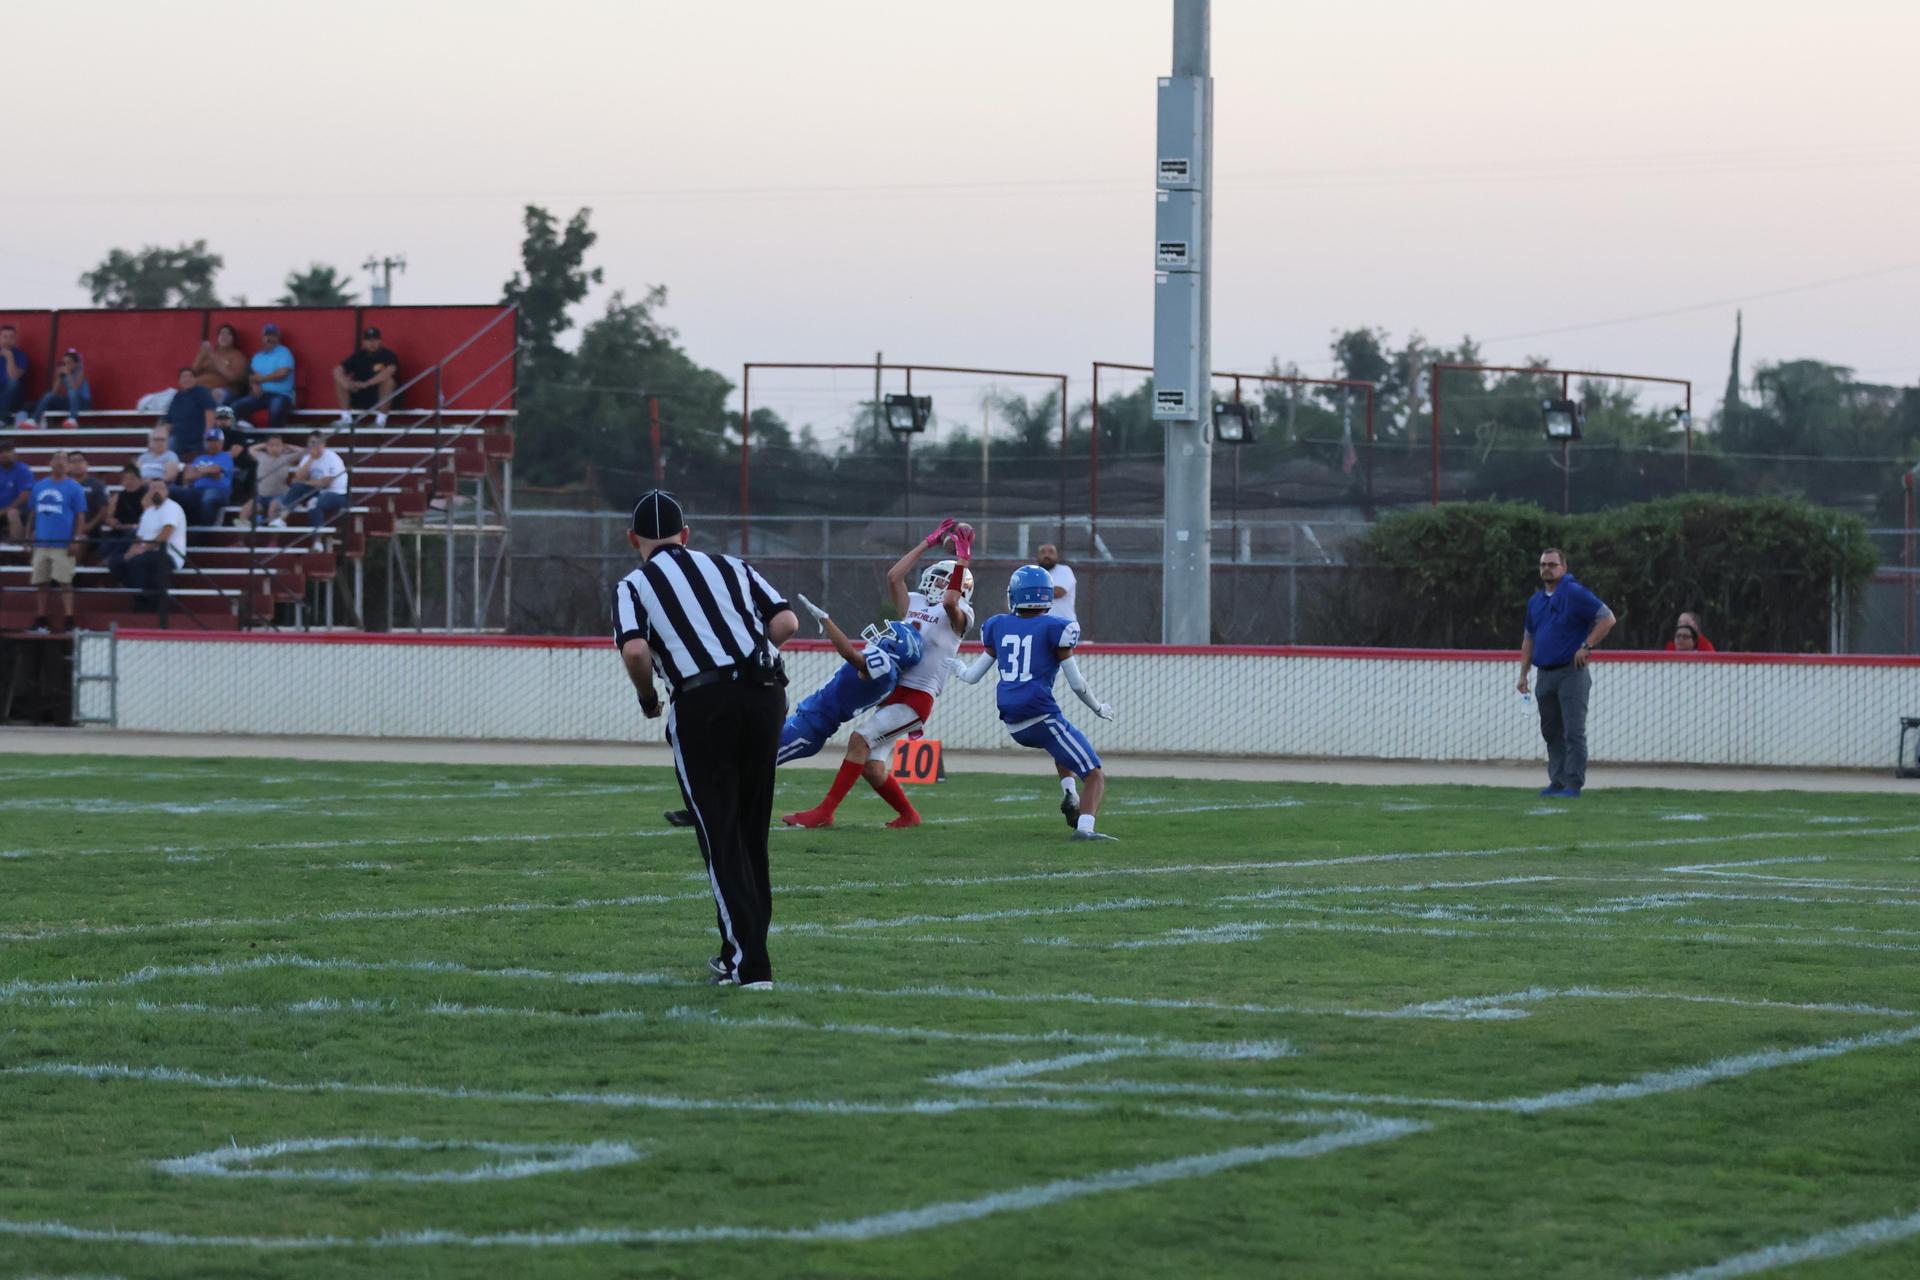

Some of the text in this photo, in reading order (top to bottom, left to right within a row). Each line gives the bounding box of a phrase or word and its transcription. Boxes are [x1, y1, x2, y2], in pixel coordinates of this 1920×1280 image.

[864, 649, 884, 669] 10
[1000, 634, 1033, 682] 31
[894, 742, 934, 779] 10
